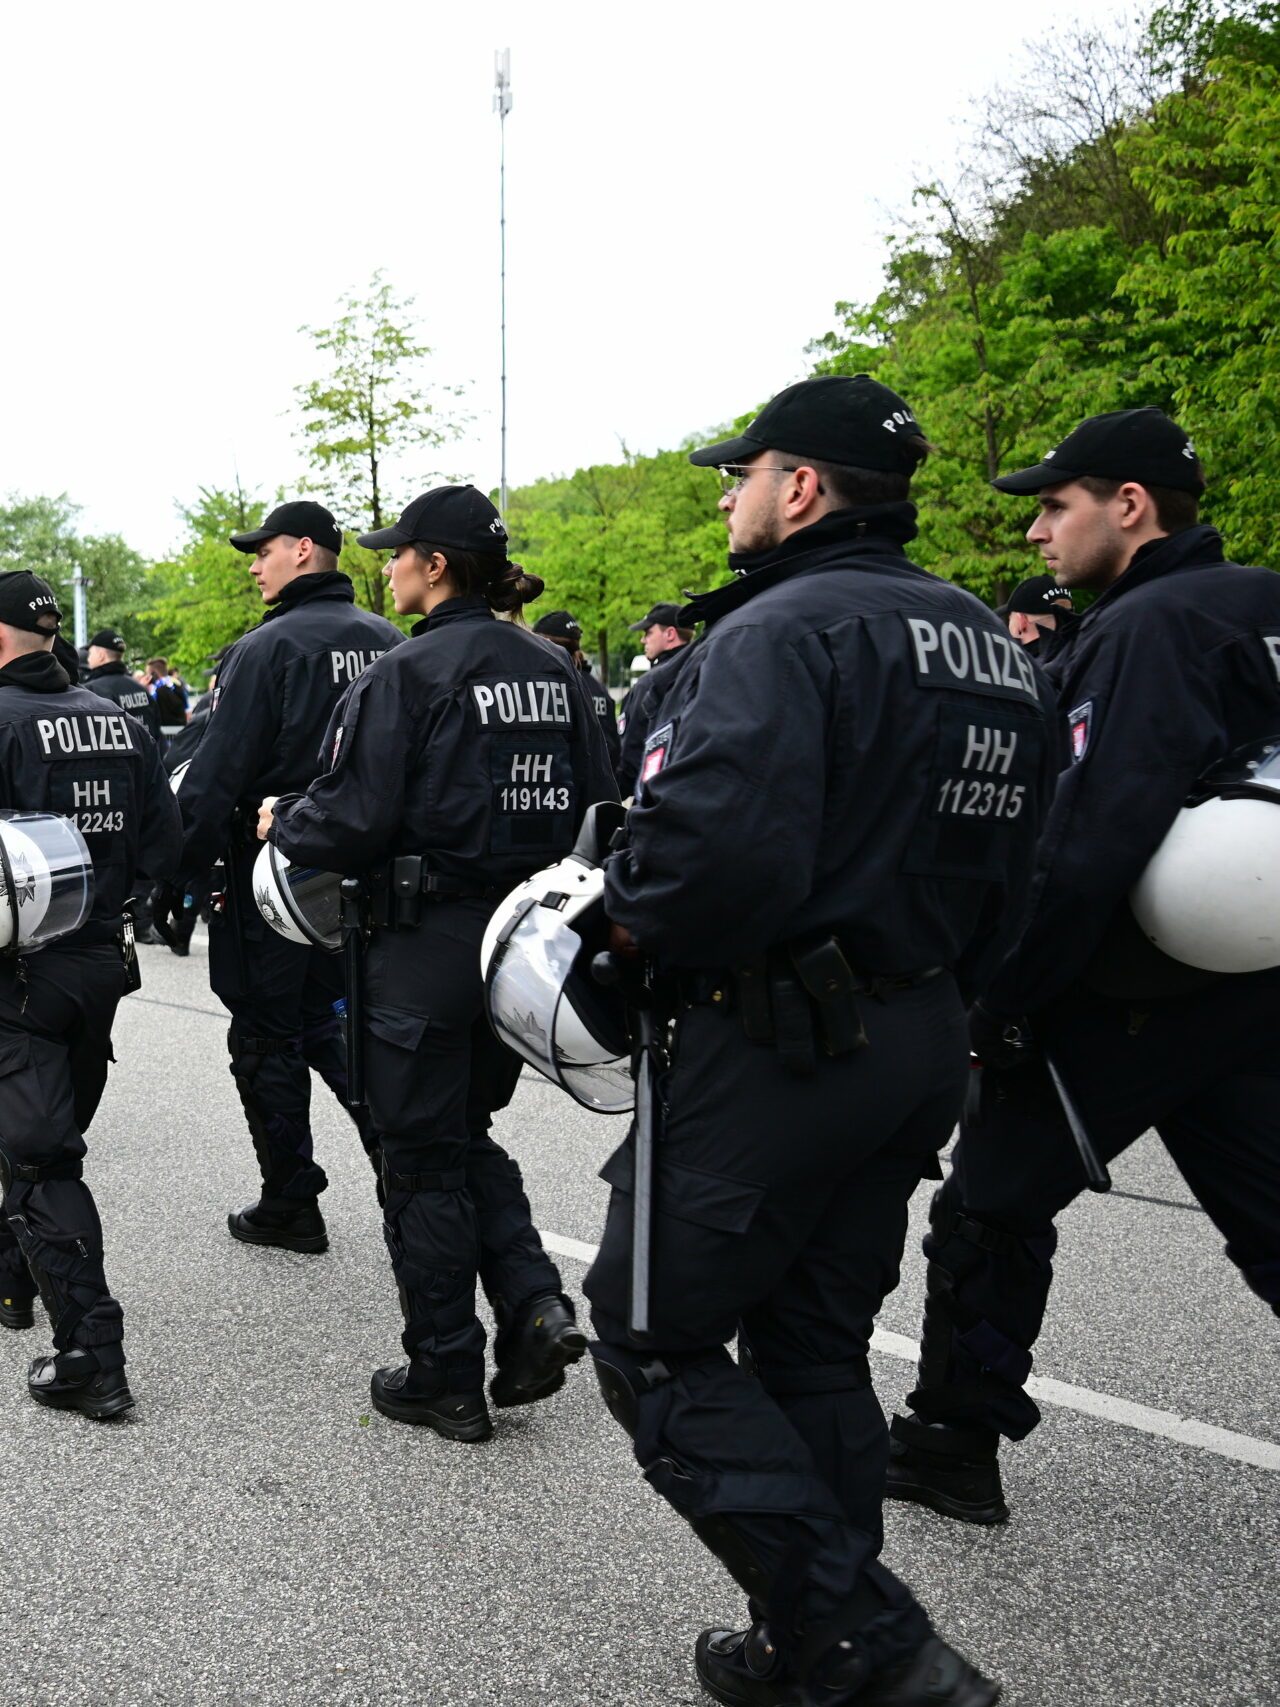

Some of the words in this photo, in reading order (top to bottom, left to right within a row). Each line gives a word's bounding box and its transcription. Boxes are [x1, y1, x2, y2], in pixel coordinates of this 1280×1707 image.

[908, 618, 1039, 701] POLIZEI
[119, 691, 150, 709] POLIZEI
[473, 681, 571, 724] POLIZEI
[37, 715, 134, 755] POLIZEI
[962, 725, 1017, 775] HH
[511, 754, 553, 782] HH
[73, 780, 111, 808] HH
[500, 787, 569, 811] 119143
[938, 779, 1026, 818] 112315
